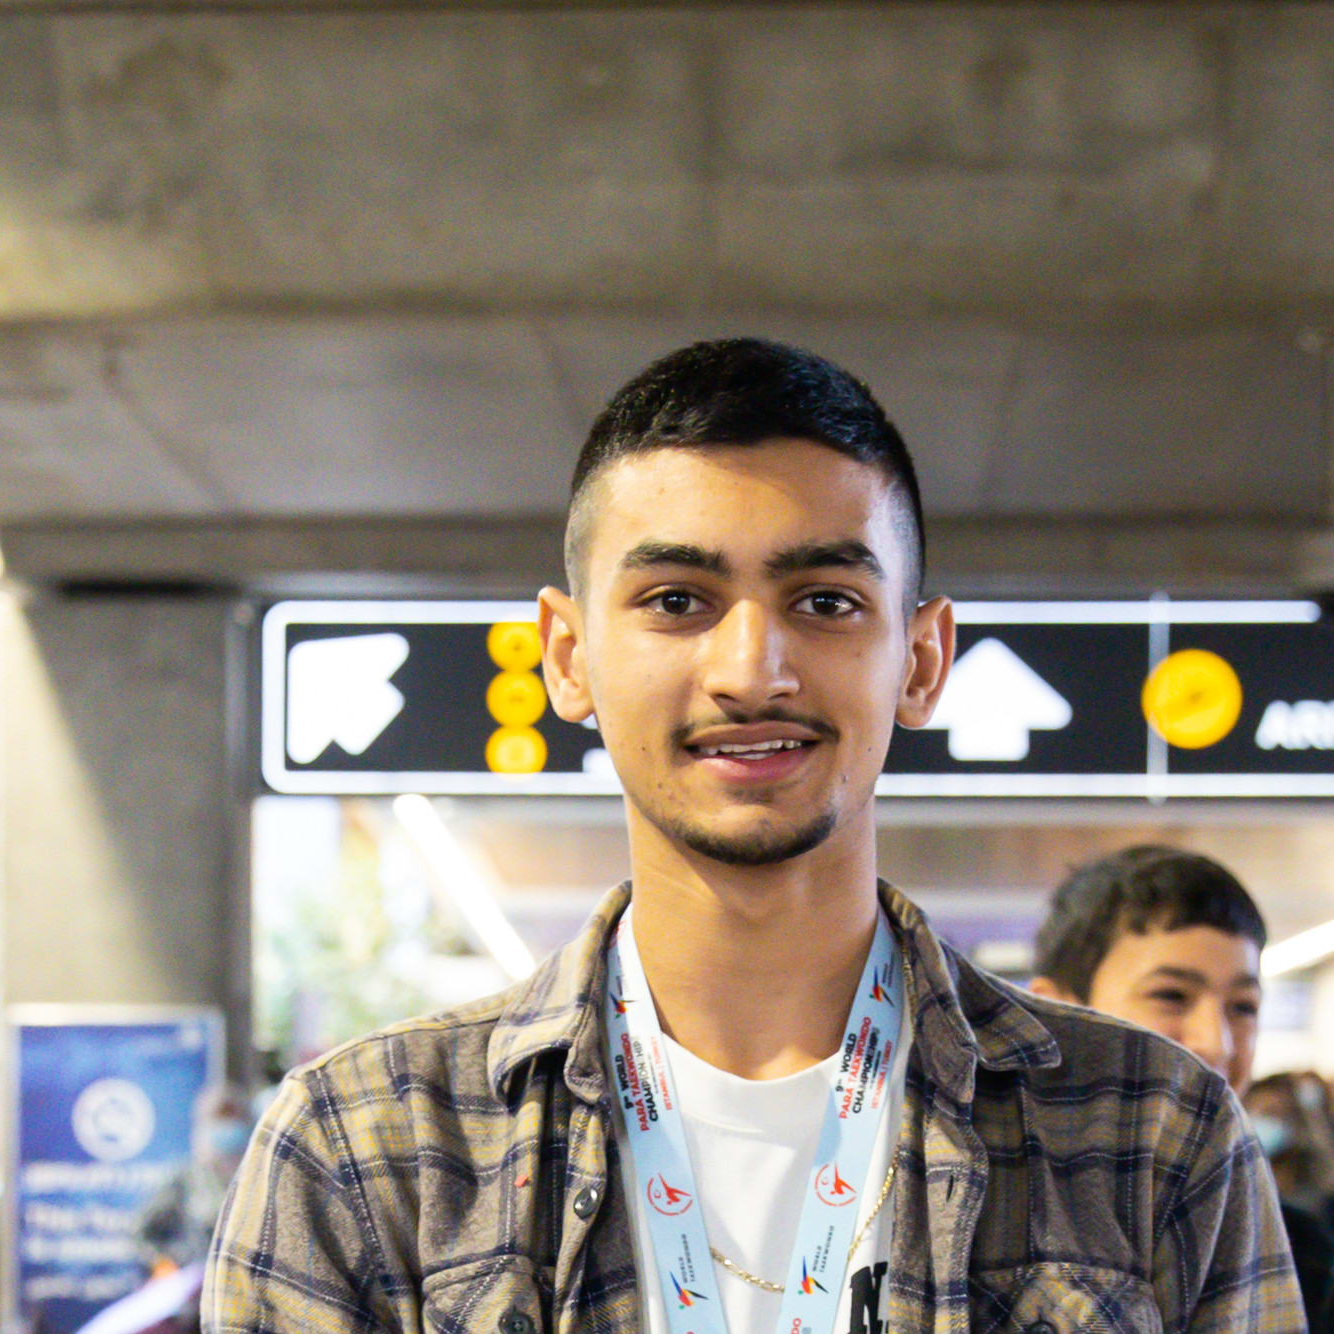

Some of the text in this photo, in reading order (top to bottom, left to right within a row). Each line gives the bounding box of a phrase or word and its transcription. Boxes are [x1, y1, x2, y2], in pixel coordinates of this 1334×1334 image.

[841, 1033, 857, 1073] WORLD
[852, 1026, 880, 1114] CHAMPIONHIP
[615, 1055, 629, 1091] WORLD
[631, 1036, 658, 1121] CHAMPIONHIP
[635, 1098, 650, 1131] PARA
[838, 1087, 854, 1119] PARA
